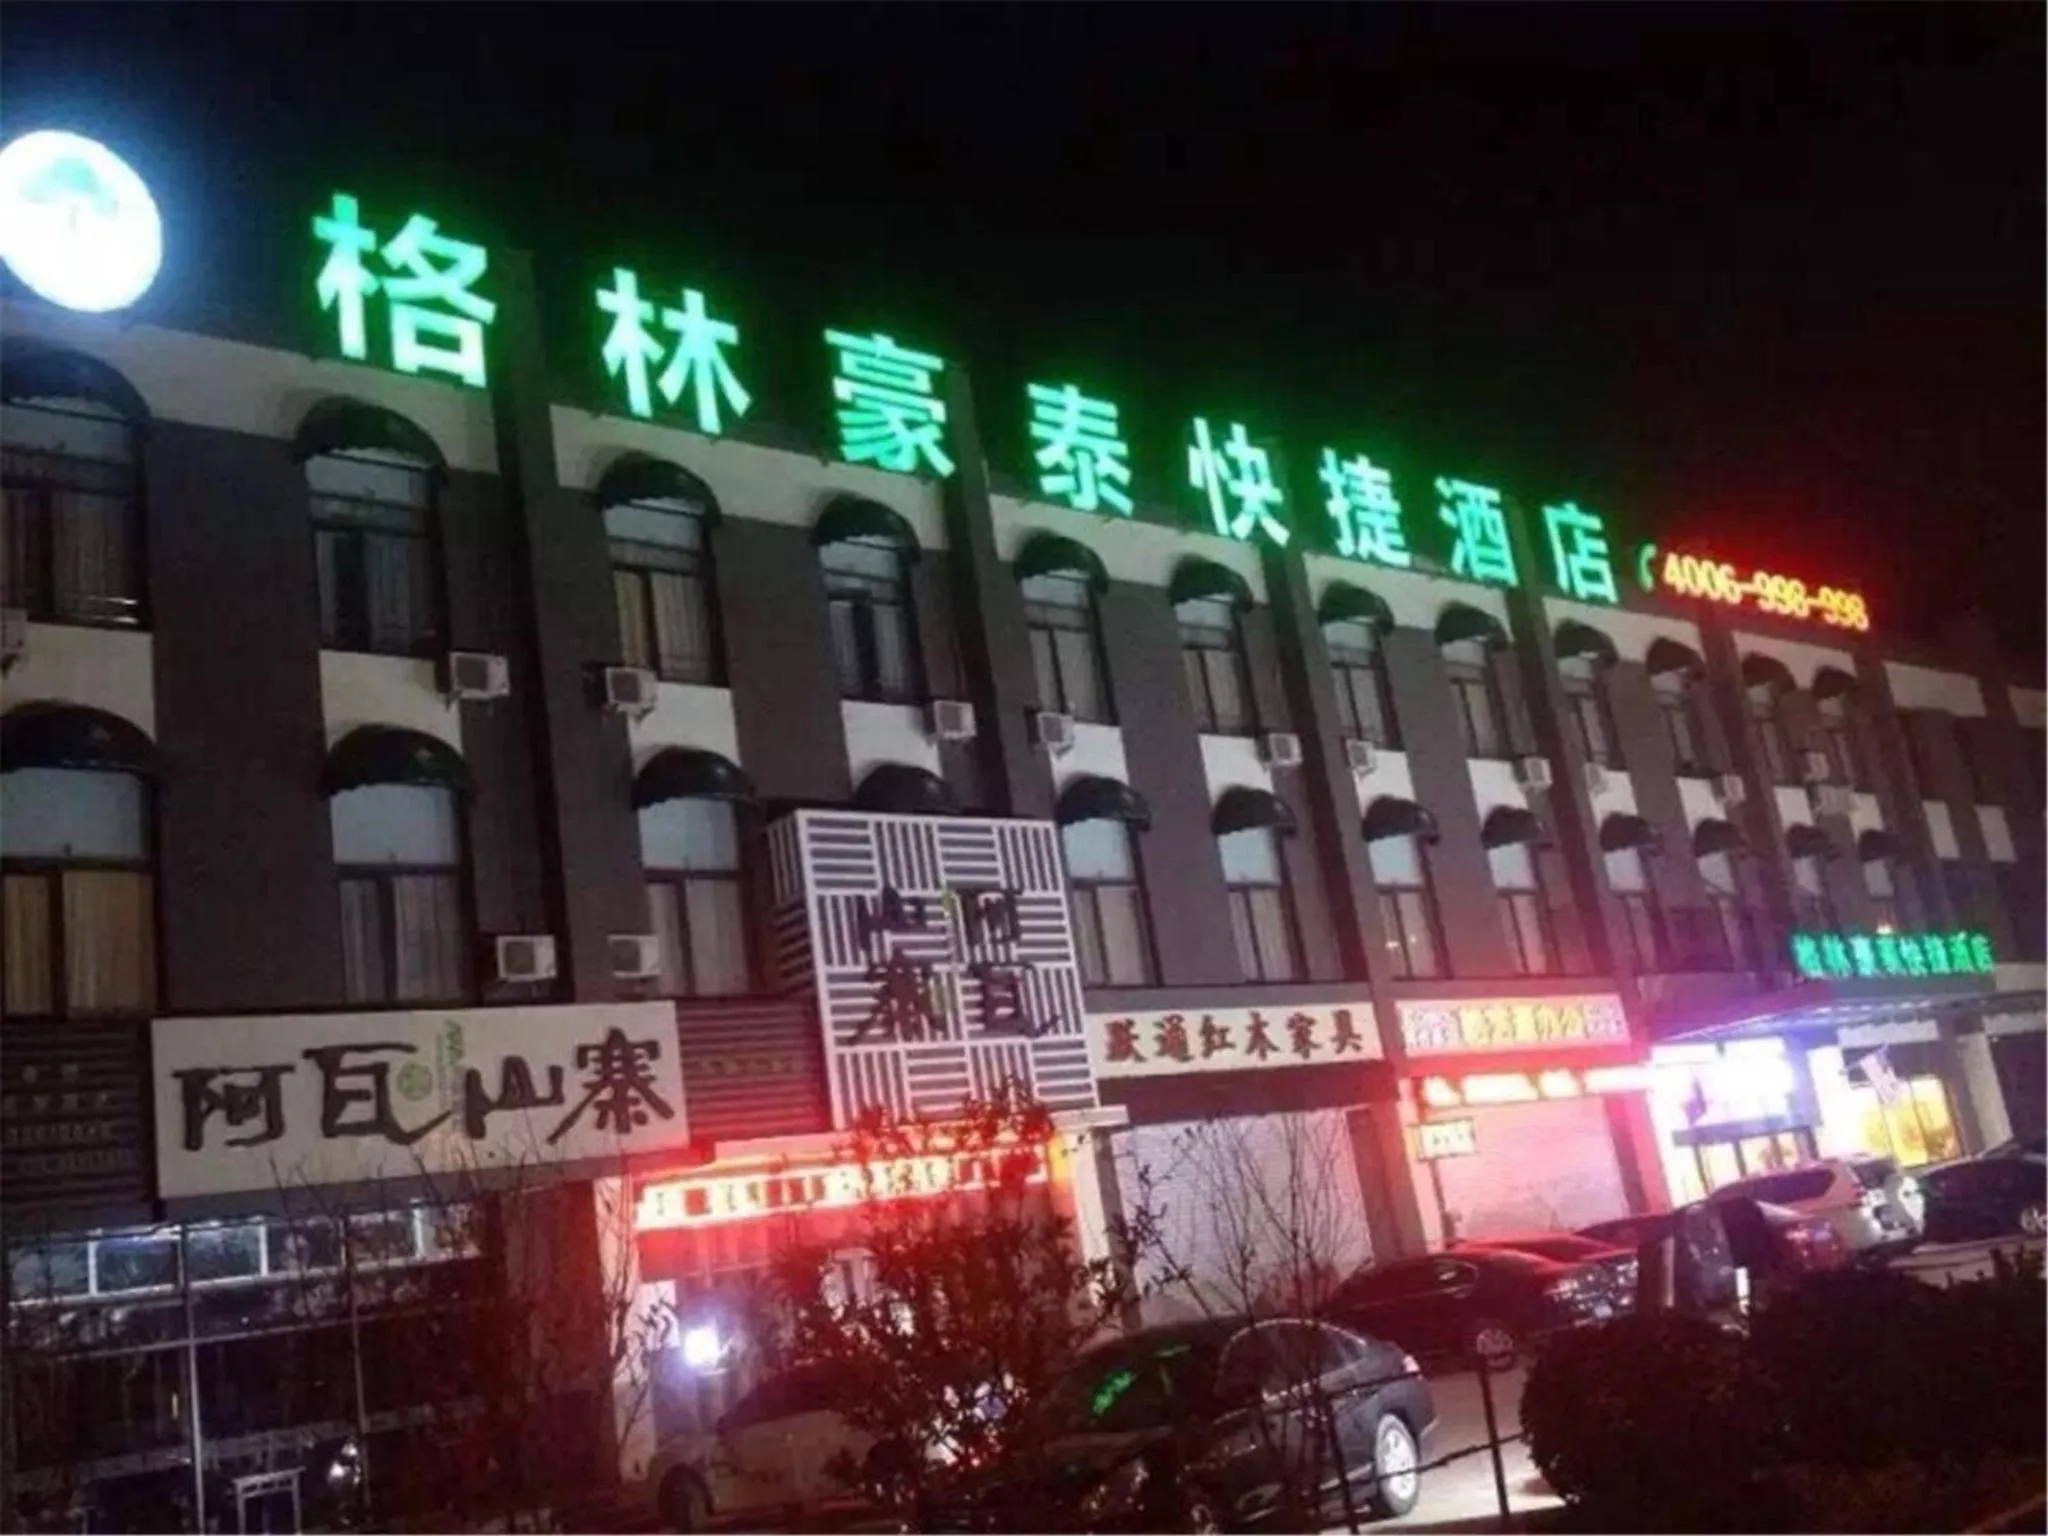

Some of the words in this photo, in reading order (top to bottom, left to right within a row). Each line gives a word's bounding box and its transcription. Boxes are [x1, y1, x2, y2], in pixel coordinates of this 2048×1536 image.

[312, 193, 1620, 604] 格林豪泰快捷酒店
[1663, 551, 1870, 633] 4006-998-998
[172, 1026, 676, 1152] 阿瓦山寨
[1105, 1008, 1365, 1063] 跃通红木家具
